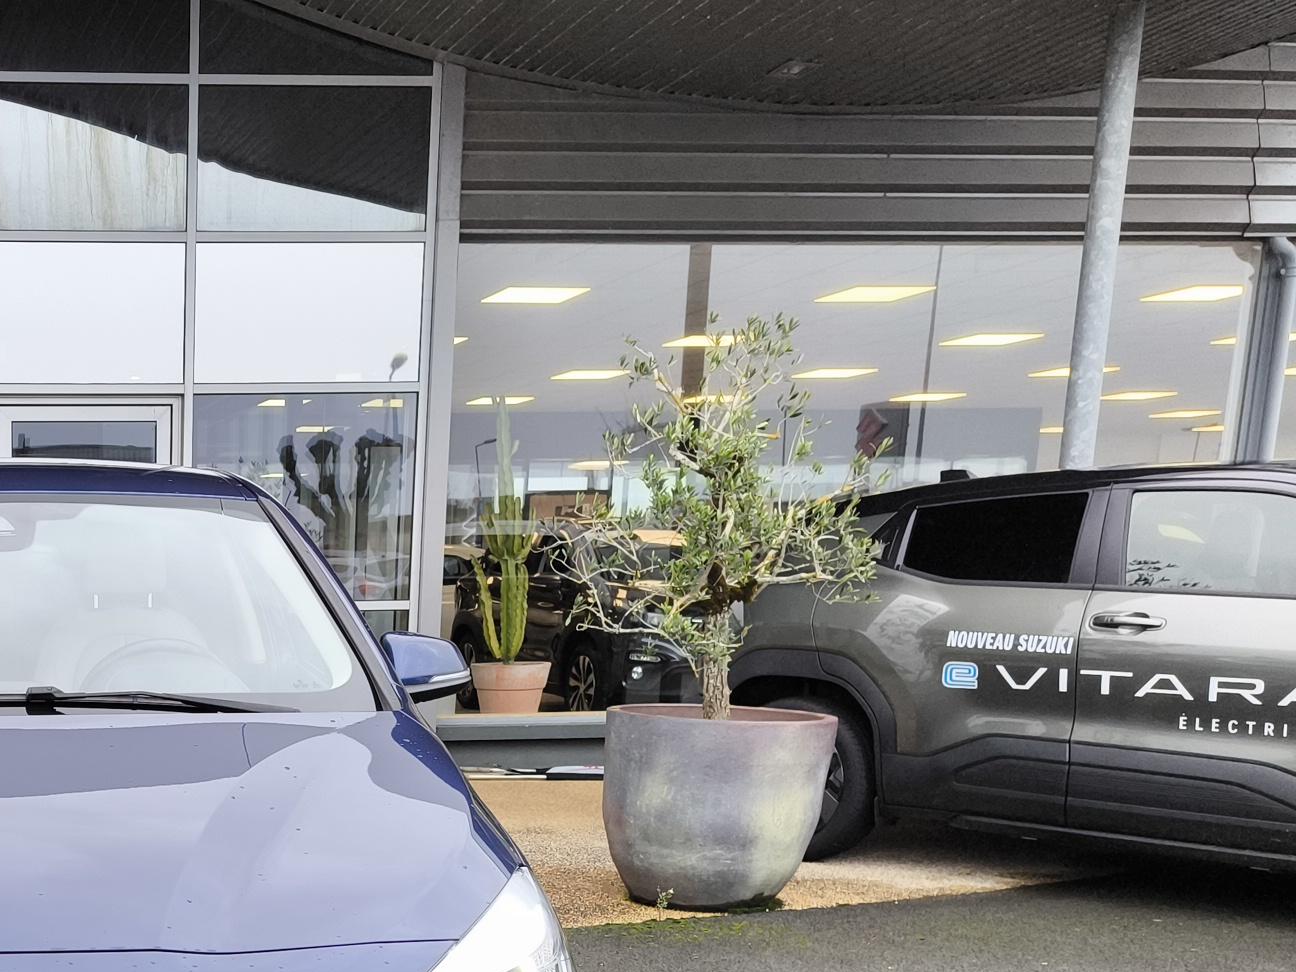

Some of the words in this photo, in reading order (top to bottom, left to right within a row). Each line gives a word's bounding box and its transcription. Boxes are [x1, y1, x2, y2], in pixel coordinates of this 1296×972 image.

[946, 630, 1015, 651] NOUVEAU
[1017, 634, 1074, 655] SUZUKI
[1178, 712, 1288, 738] ÉLECTRI
